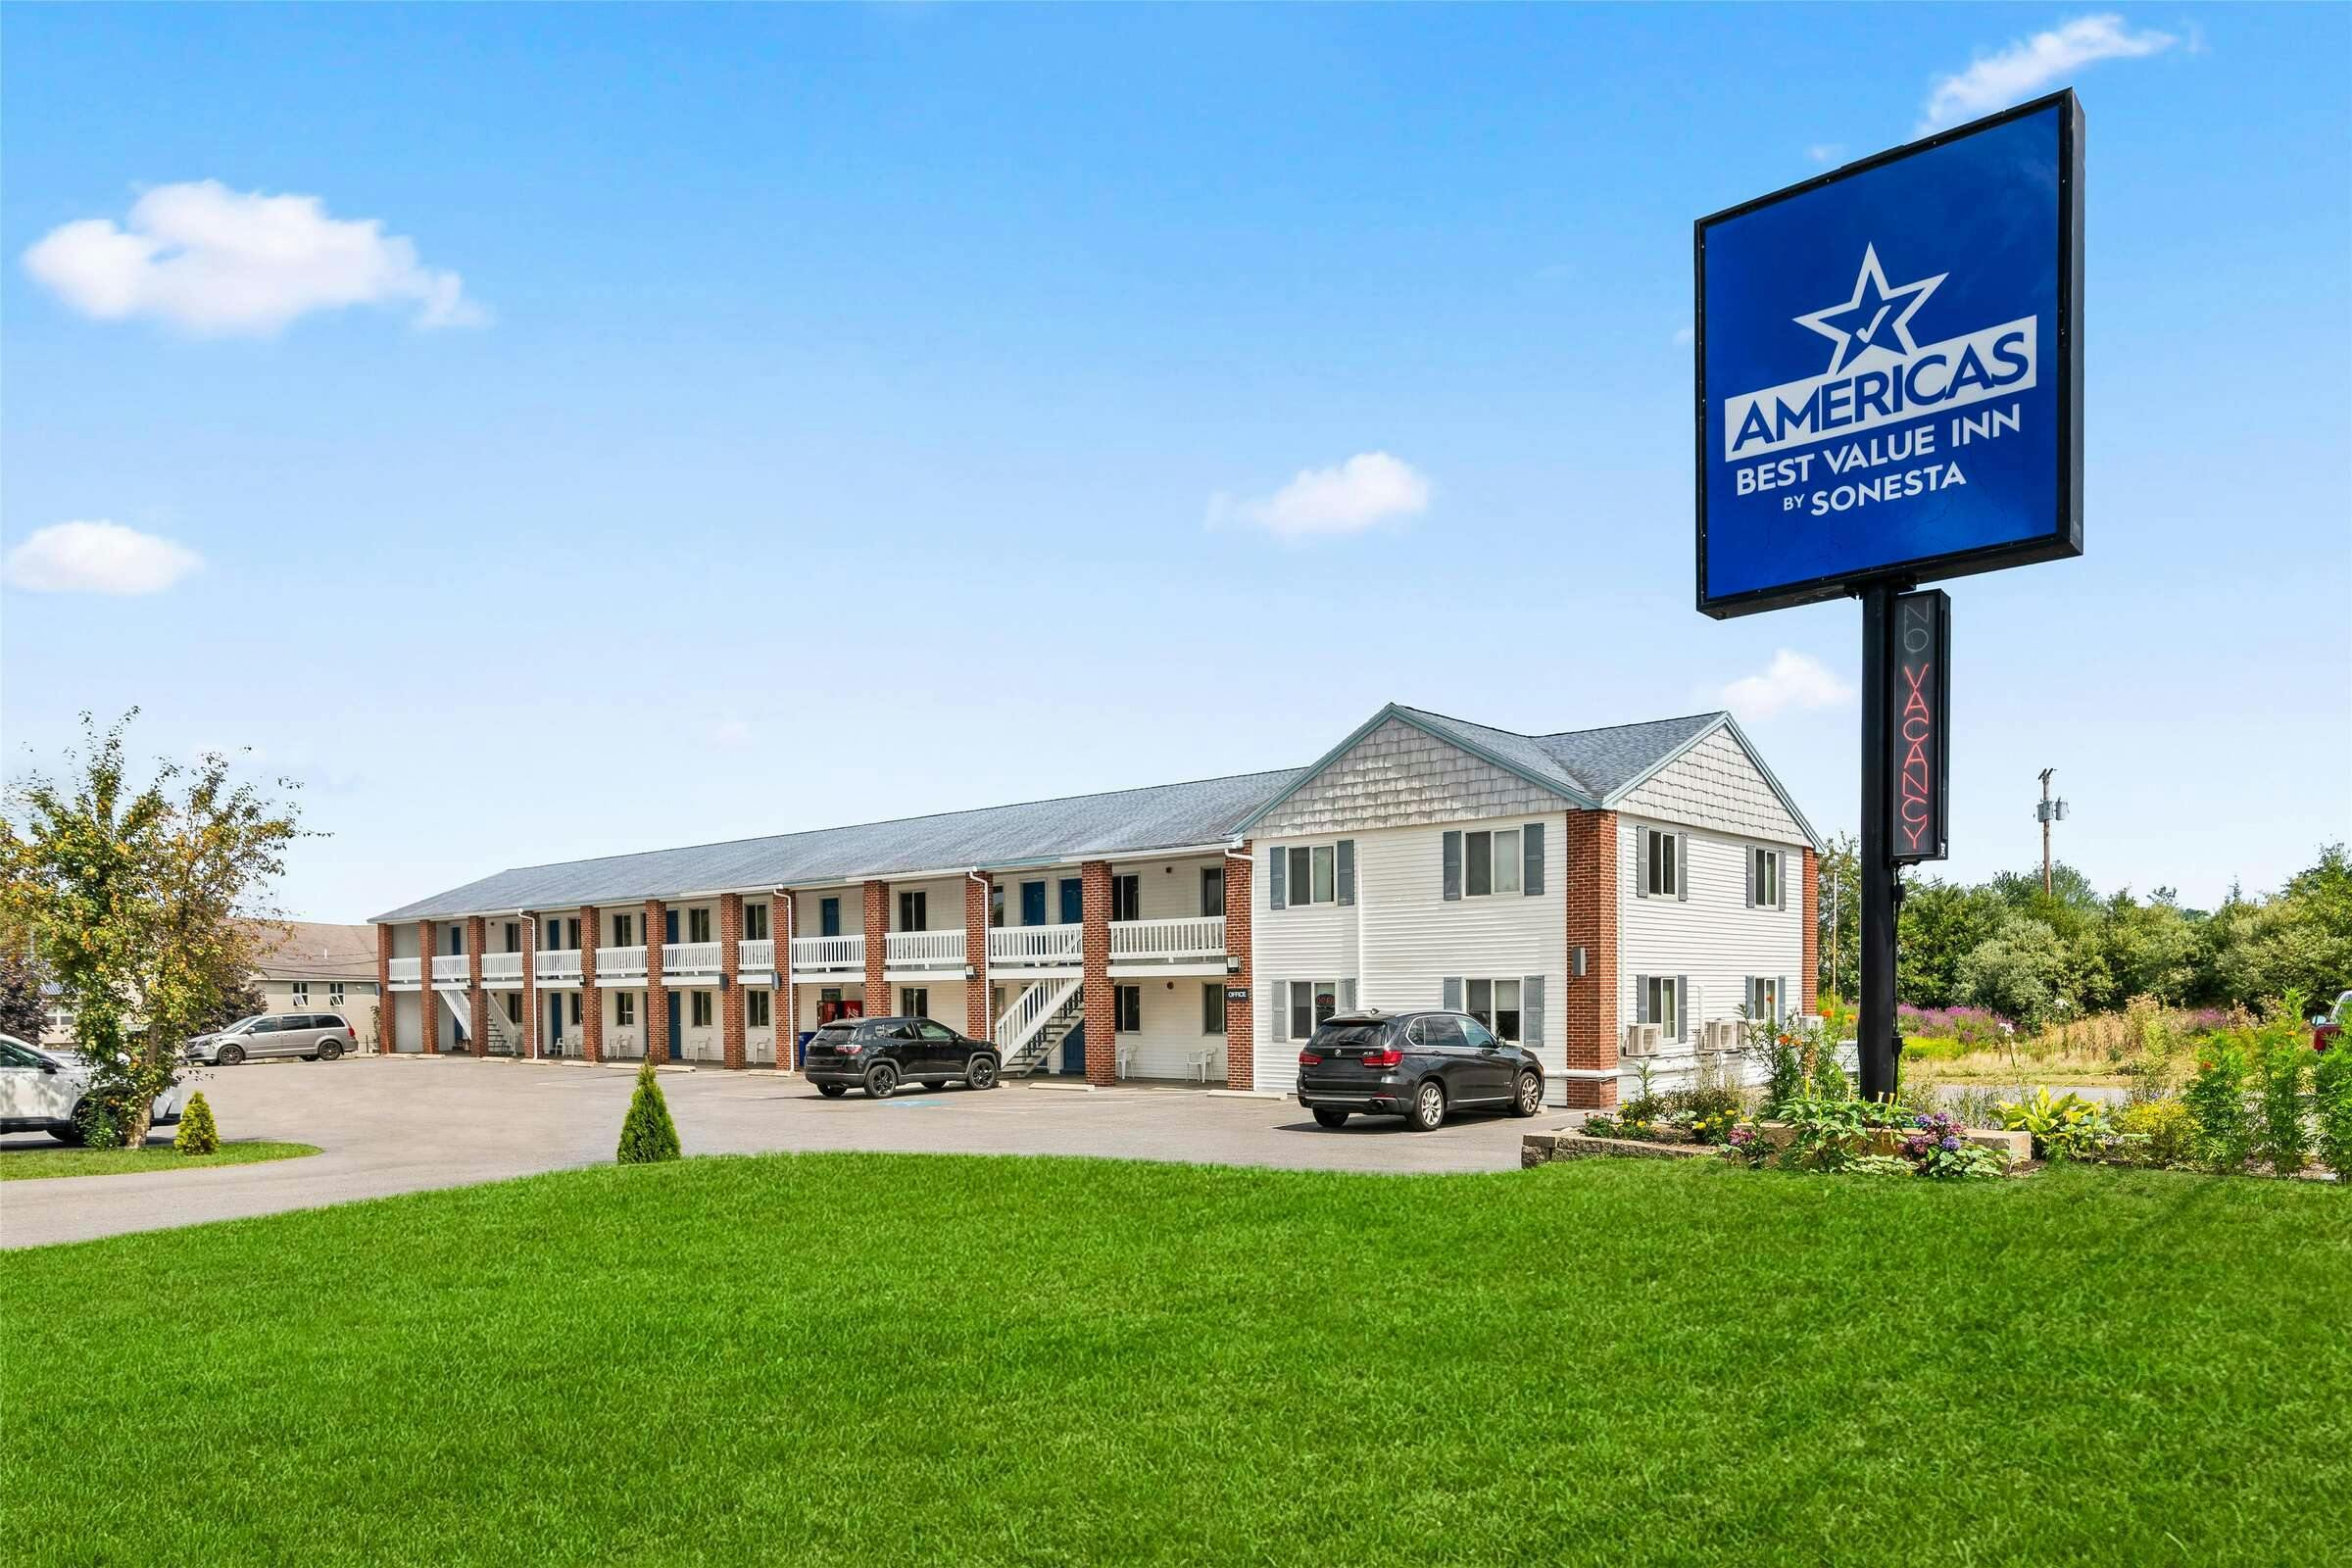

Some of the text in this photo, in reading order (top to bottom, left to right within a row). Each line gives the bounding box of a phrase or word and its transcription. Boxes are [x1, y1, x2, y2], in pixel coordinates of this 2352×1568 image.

[1732, 331, 2029, 452] AMERICAS
[1737, 403, 2021, 496] BEST VALUE INN
[1783, 461, 1967, 516] BY SONESTA
[1901, 600, 1930, 850] NO VACANCY
